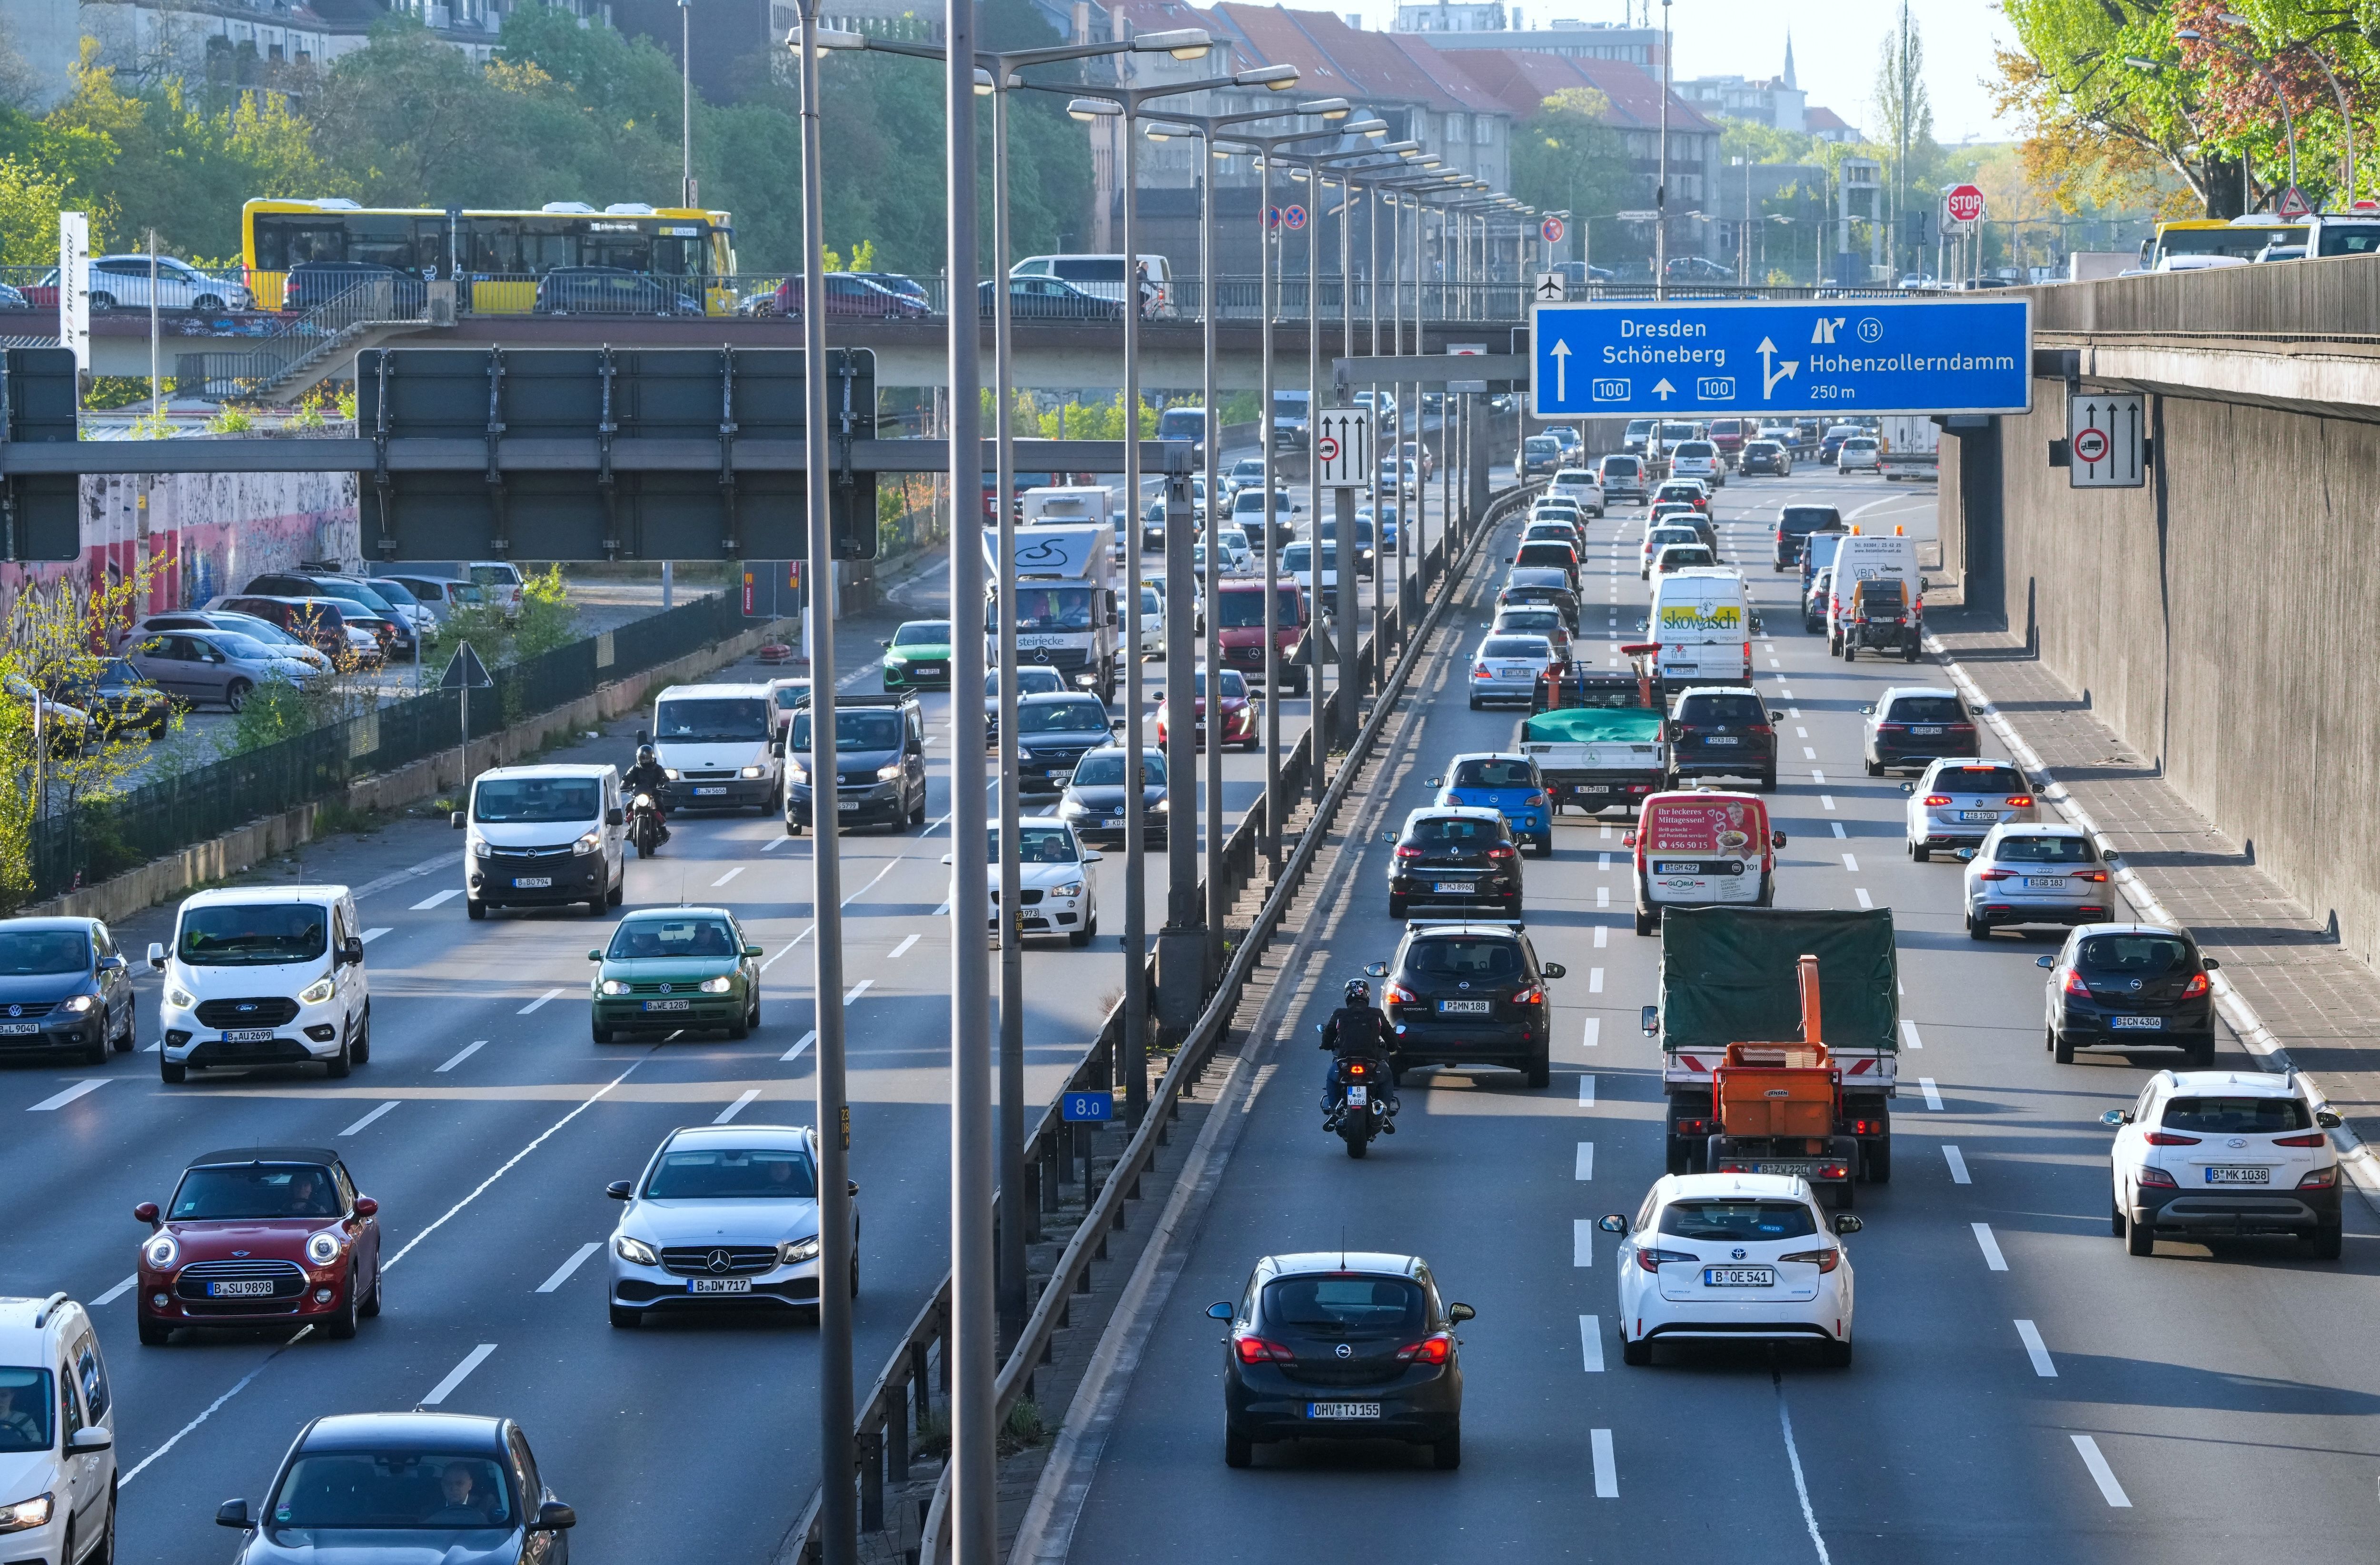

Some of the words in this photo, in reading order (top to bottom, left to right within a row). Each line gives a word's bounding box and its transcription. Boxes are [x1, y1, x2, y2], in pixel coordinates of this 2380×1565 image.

[1951, 195, 1981, 211] STOP
[2272, 234, 2283, 242] 110
[1622, 320, 1706, 338] Dresden
[1862, 322, 1878, 337] 13
[1603, 346, 1725, 366] Schöneberg
[1810, 353, 2014, 372] Hohenzollerndamm
[1599, 383, 1624, 397] 100
[1704, 382, 1729, 396] 100
[1810, 385, 1837, 399] 250
[1843, 388, 1855, 399] m
[1664, 610, 1737, 630] skowasch
[1019, 635, 1064, 647] steinecke
[1016, 913, 1022, 921] 23
[1448, 1002, 1452, 1010] P
[1458, 1002, 1468, 1010] MN
[1471, 1002, 1486, 1010] 188
[1076, 1099, 1100, 1116] 8,0
[842, 1109, 849, 1120] 23
[842, 1122, 849, 1133] 08
[1762, 1164, 1767, 1174] B
[1775, 1164, 1787, 1174] ZW
[2213, 1170, 2219, 1179] B
[2226, 1170, 2239, 1179] MK
[2241, 1169, 2266, 1179] 1038
[1716, 1271, 1722, 1282] B
[1731, 1271, 1744, 1282] OE
[1745, 1271, 1766, 1282] 541
[215, 1284, 221, 1293] B
[229, 1283, 243, 1293] SU
[245, 1282, 272, 1292] 9898
[697, 1281, 704, 1290] B
[711, 1280, 724, 1290] DW
[727, 1280, 746, 1290] 717
[1315, 1404, 1335, 1416] OHV
[1344, 1404, 1357, 1416] TJ
[1359, 1404, 1379, 1416] 155
